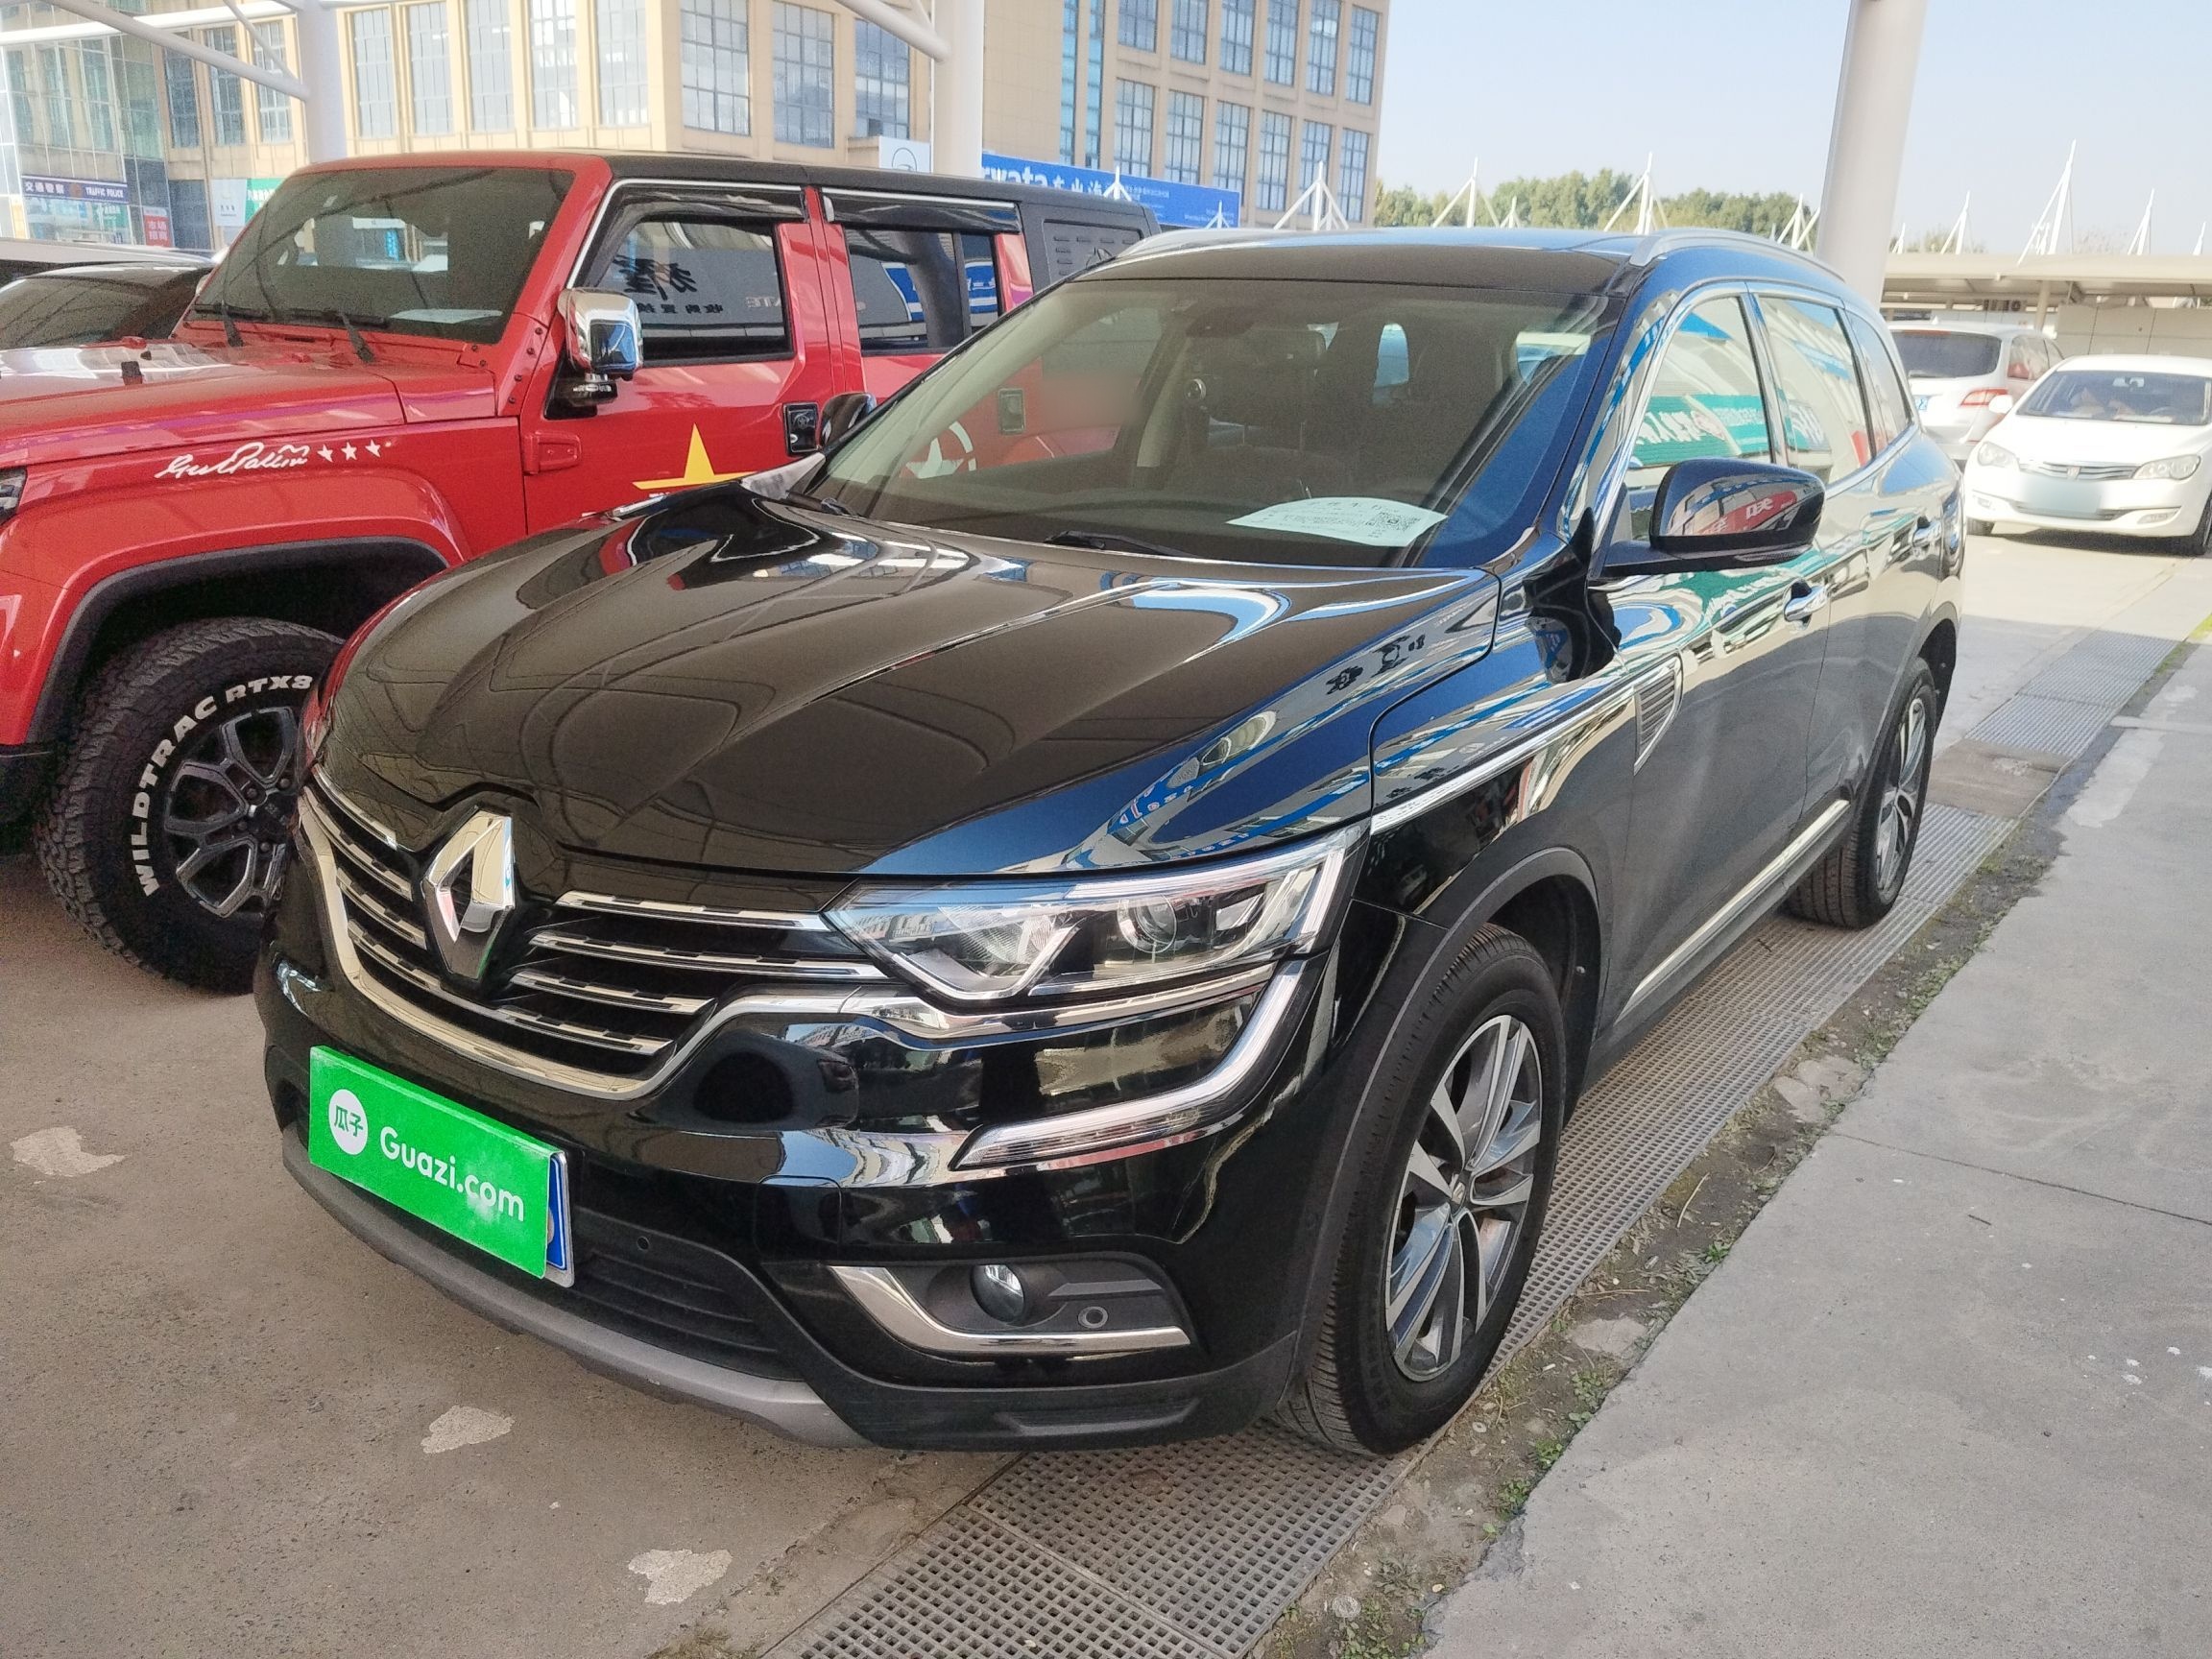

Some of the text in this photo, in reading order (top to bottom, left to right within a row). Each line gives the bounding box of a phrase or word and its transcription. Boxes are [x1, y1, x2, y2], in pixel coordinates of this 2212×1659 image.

[84, 186, 124, 199] TRAFFIC POLICE
[131, 695, 218, 897] WILDTRAC
[333, 1105, 365, 1138] 瓜子
[379, 1126, 525, 1222] Guazi.com
